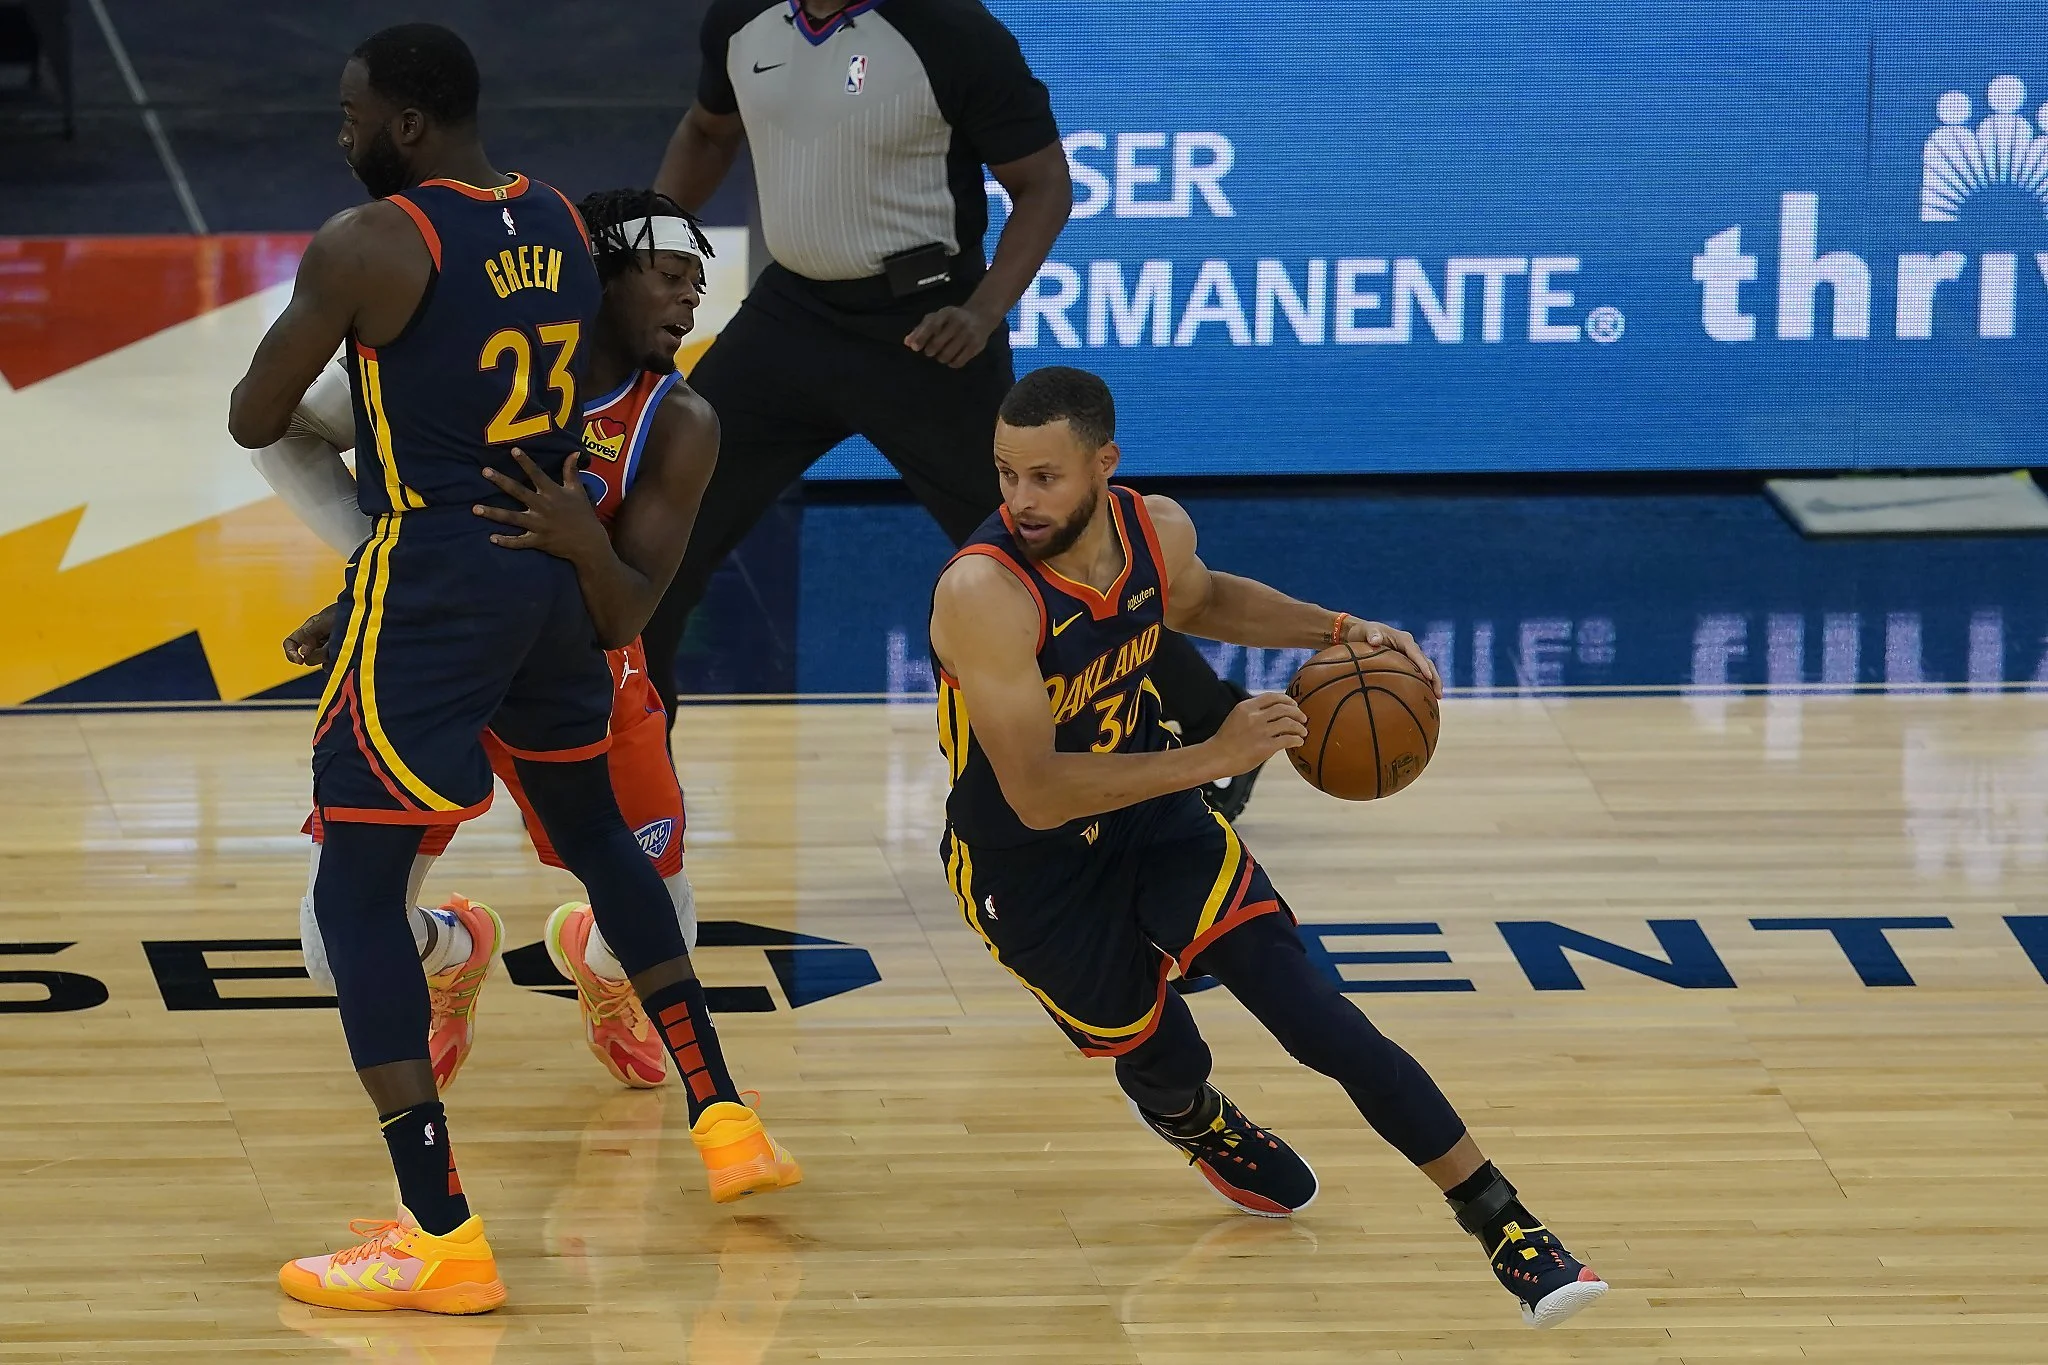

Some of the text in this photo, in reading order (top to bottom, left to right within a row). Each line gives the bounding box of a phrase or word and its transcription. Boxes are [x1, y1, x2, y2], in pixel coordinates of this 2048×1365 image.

[1060, 130, 1237, 219] SER
[484, 245, 563, 299] GREEN
[1692, 190, 2048, 342] thri
[479, 319, 582, 446] 23
[1043, 621, 1163, 726] OAKLAND
[1178, 915, 2048, 996] ENT
